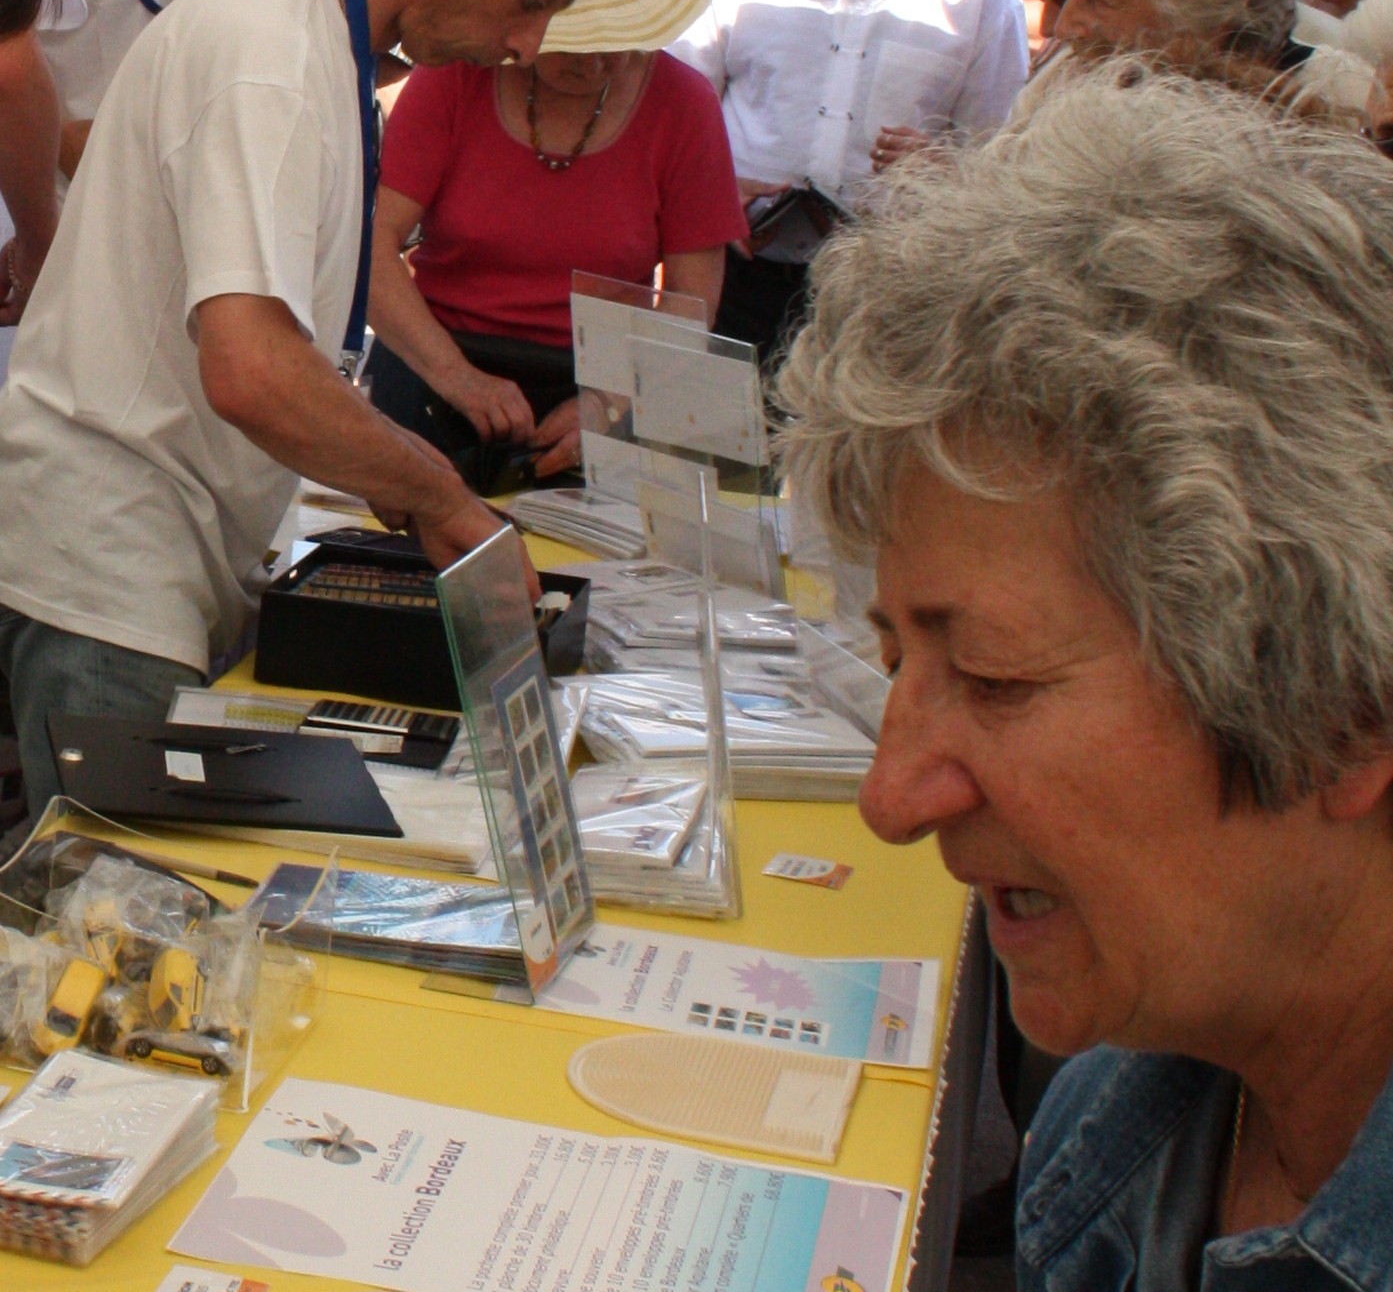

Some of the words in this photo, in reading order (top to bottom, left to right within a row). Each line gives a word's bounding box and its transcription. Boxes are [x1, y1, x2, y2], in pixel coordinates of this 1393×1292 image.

[387, 1127, 415, 1151] Poste
[381, 1150, 402, 1162] La
[414, 1137, 466, 1196] Bordeaux
[369, 1161, 396, 1183] Avec
[737, 1191, 754, 1202] de
[381, 1196, 435, 1257] collection
[520, 1201, 548, 1232] timbres
[373, 1256, 404, 1271] la
[471, 1243, 504, 1279] pochette
[509, 1244, 529, 1257] de
[610, 1225, 643, 1274] enveloppes
[635, 1230, 668, 1279] enveloppes
[494, 1256, 526, 1290] planche
[581, 1247, 608, 1284] souvenir
[606, 1273, 624, 1285] 10
[659, 1246, 686, 1286] Bordeaux
[686, 1246, 715, 1286] Aquitaine
[466, 1279, 486, 1290] La
[631, 1278, 650, 1290] 10
